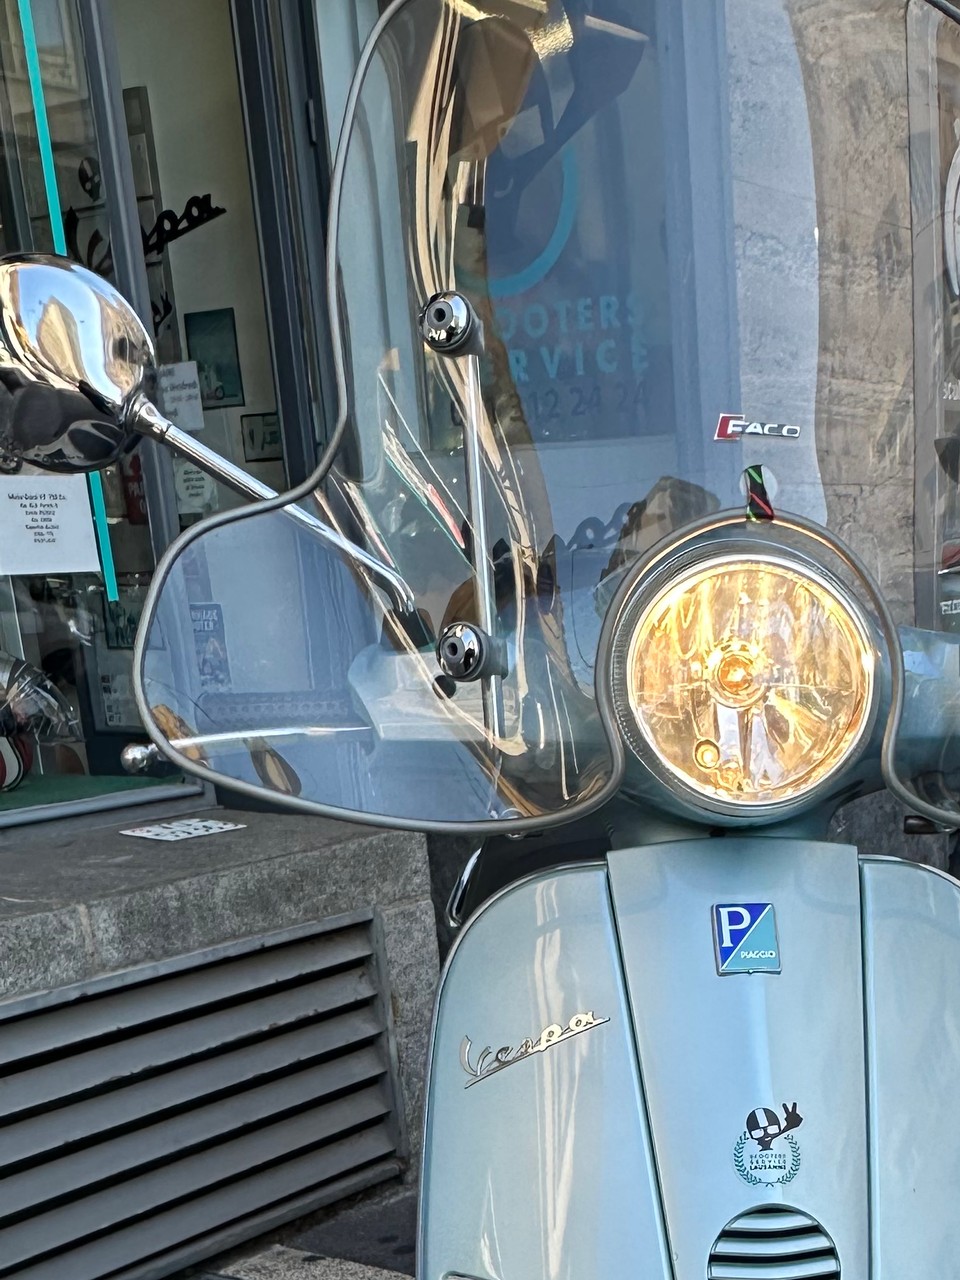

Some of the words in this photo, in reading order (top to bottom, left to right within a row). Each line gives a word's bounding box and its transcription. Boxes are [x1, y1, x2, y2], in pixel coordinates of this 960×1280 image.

[717, 414, 801, 439] FACO
[719, 907, 751, 947] P
[740, 950, 776, 959] PIAGGIO
[459, 1011, 611, 1089] Vespa
